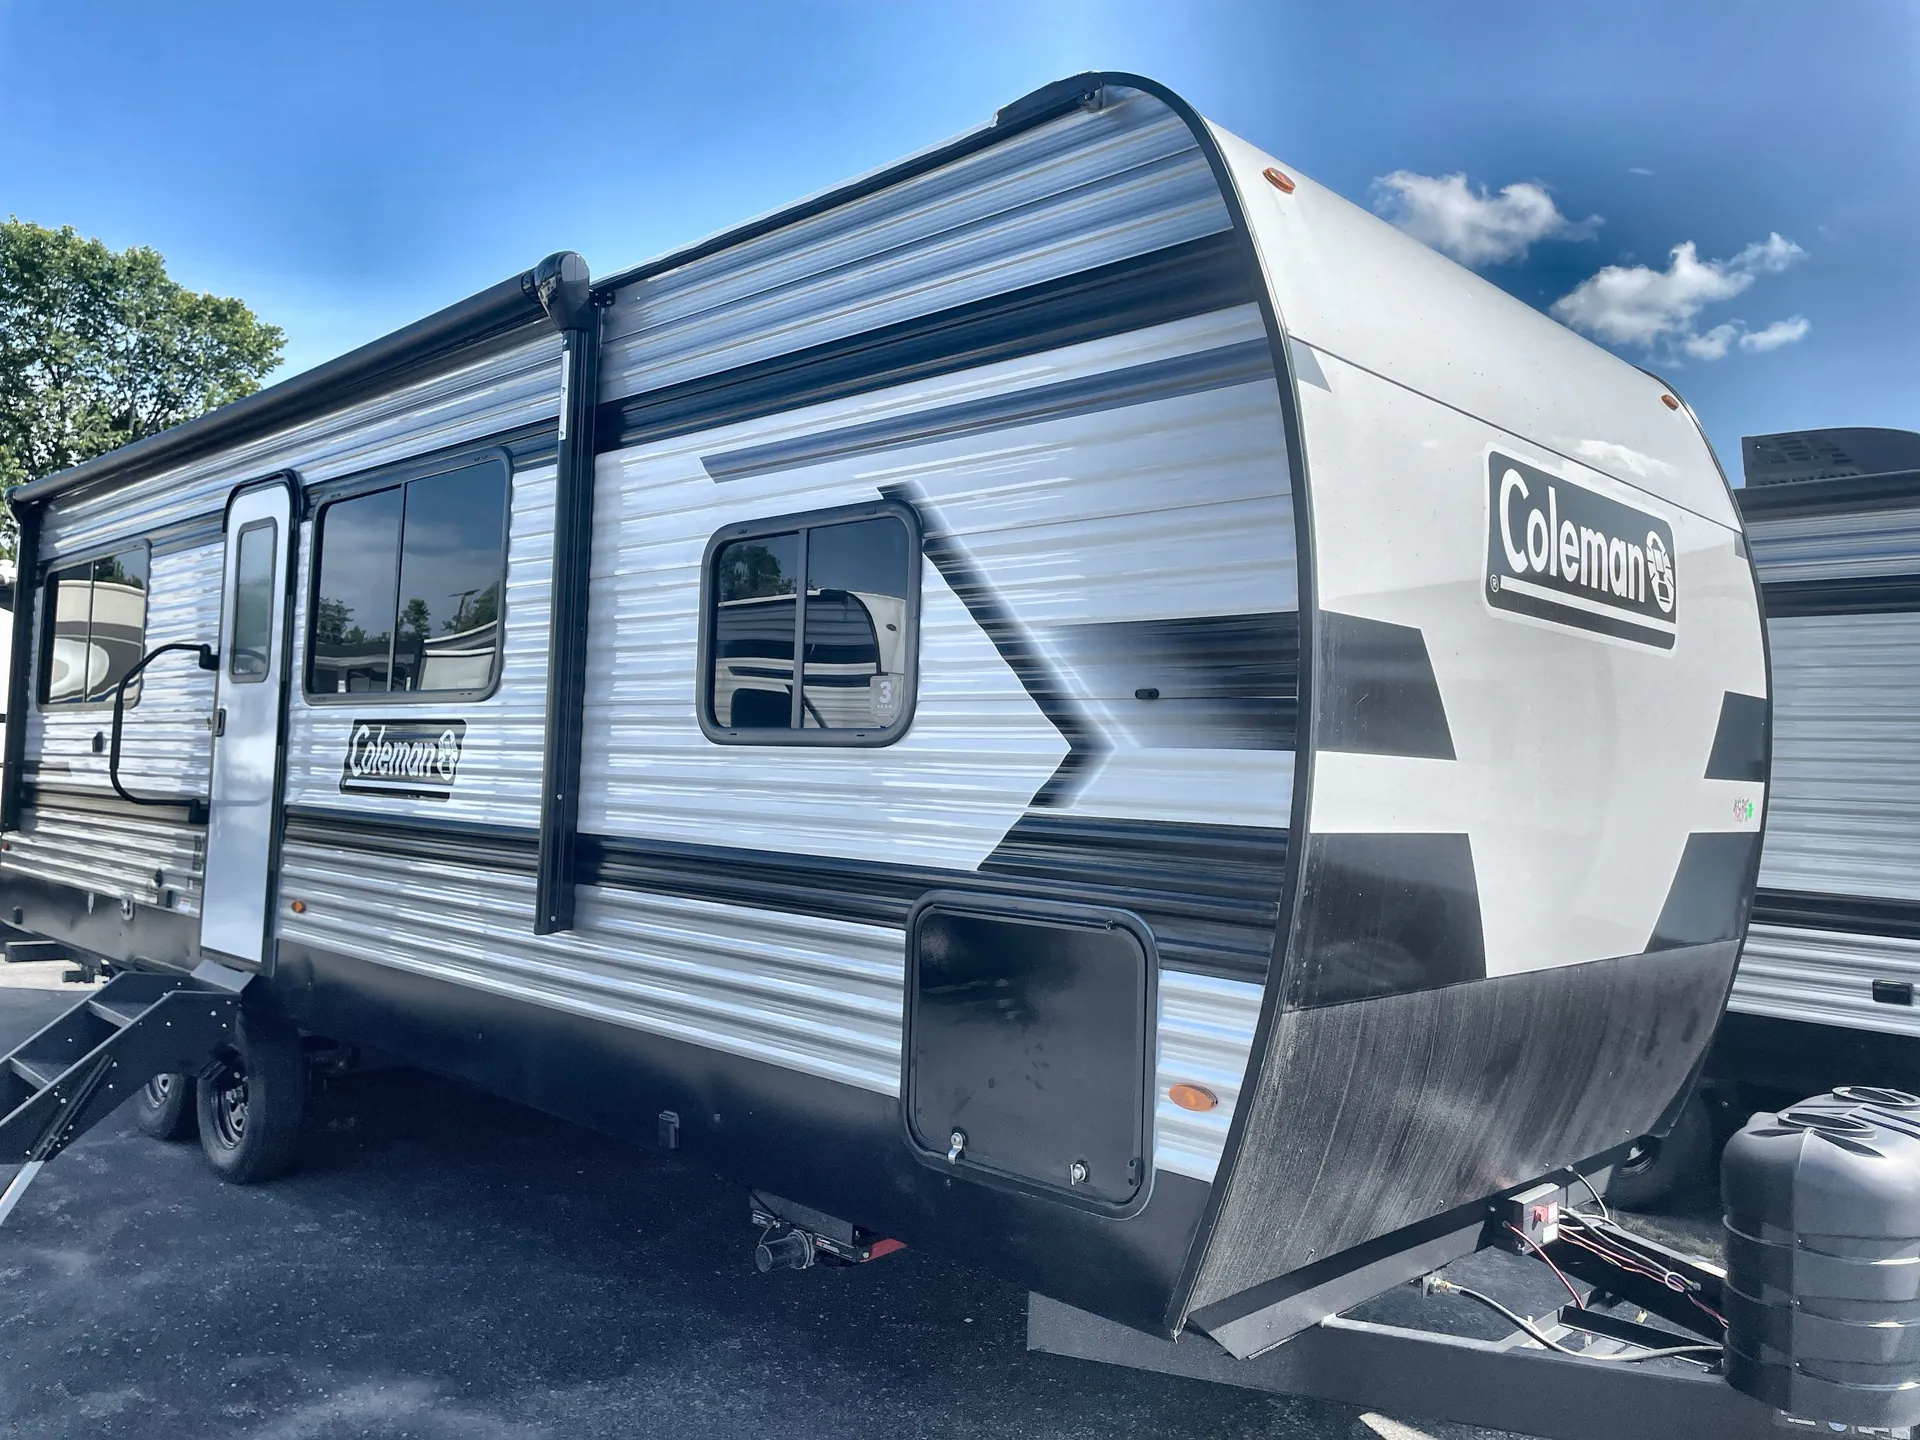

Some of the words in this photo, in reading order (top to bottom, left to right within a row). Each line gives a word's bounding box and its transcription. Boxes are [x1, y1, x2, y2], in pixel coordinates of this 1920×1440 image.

[1499, 468, 1645, 603] Coleman
[879, 681, 892, 704] 3
[350, 724, 436, 777] Coleman
